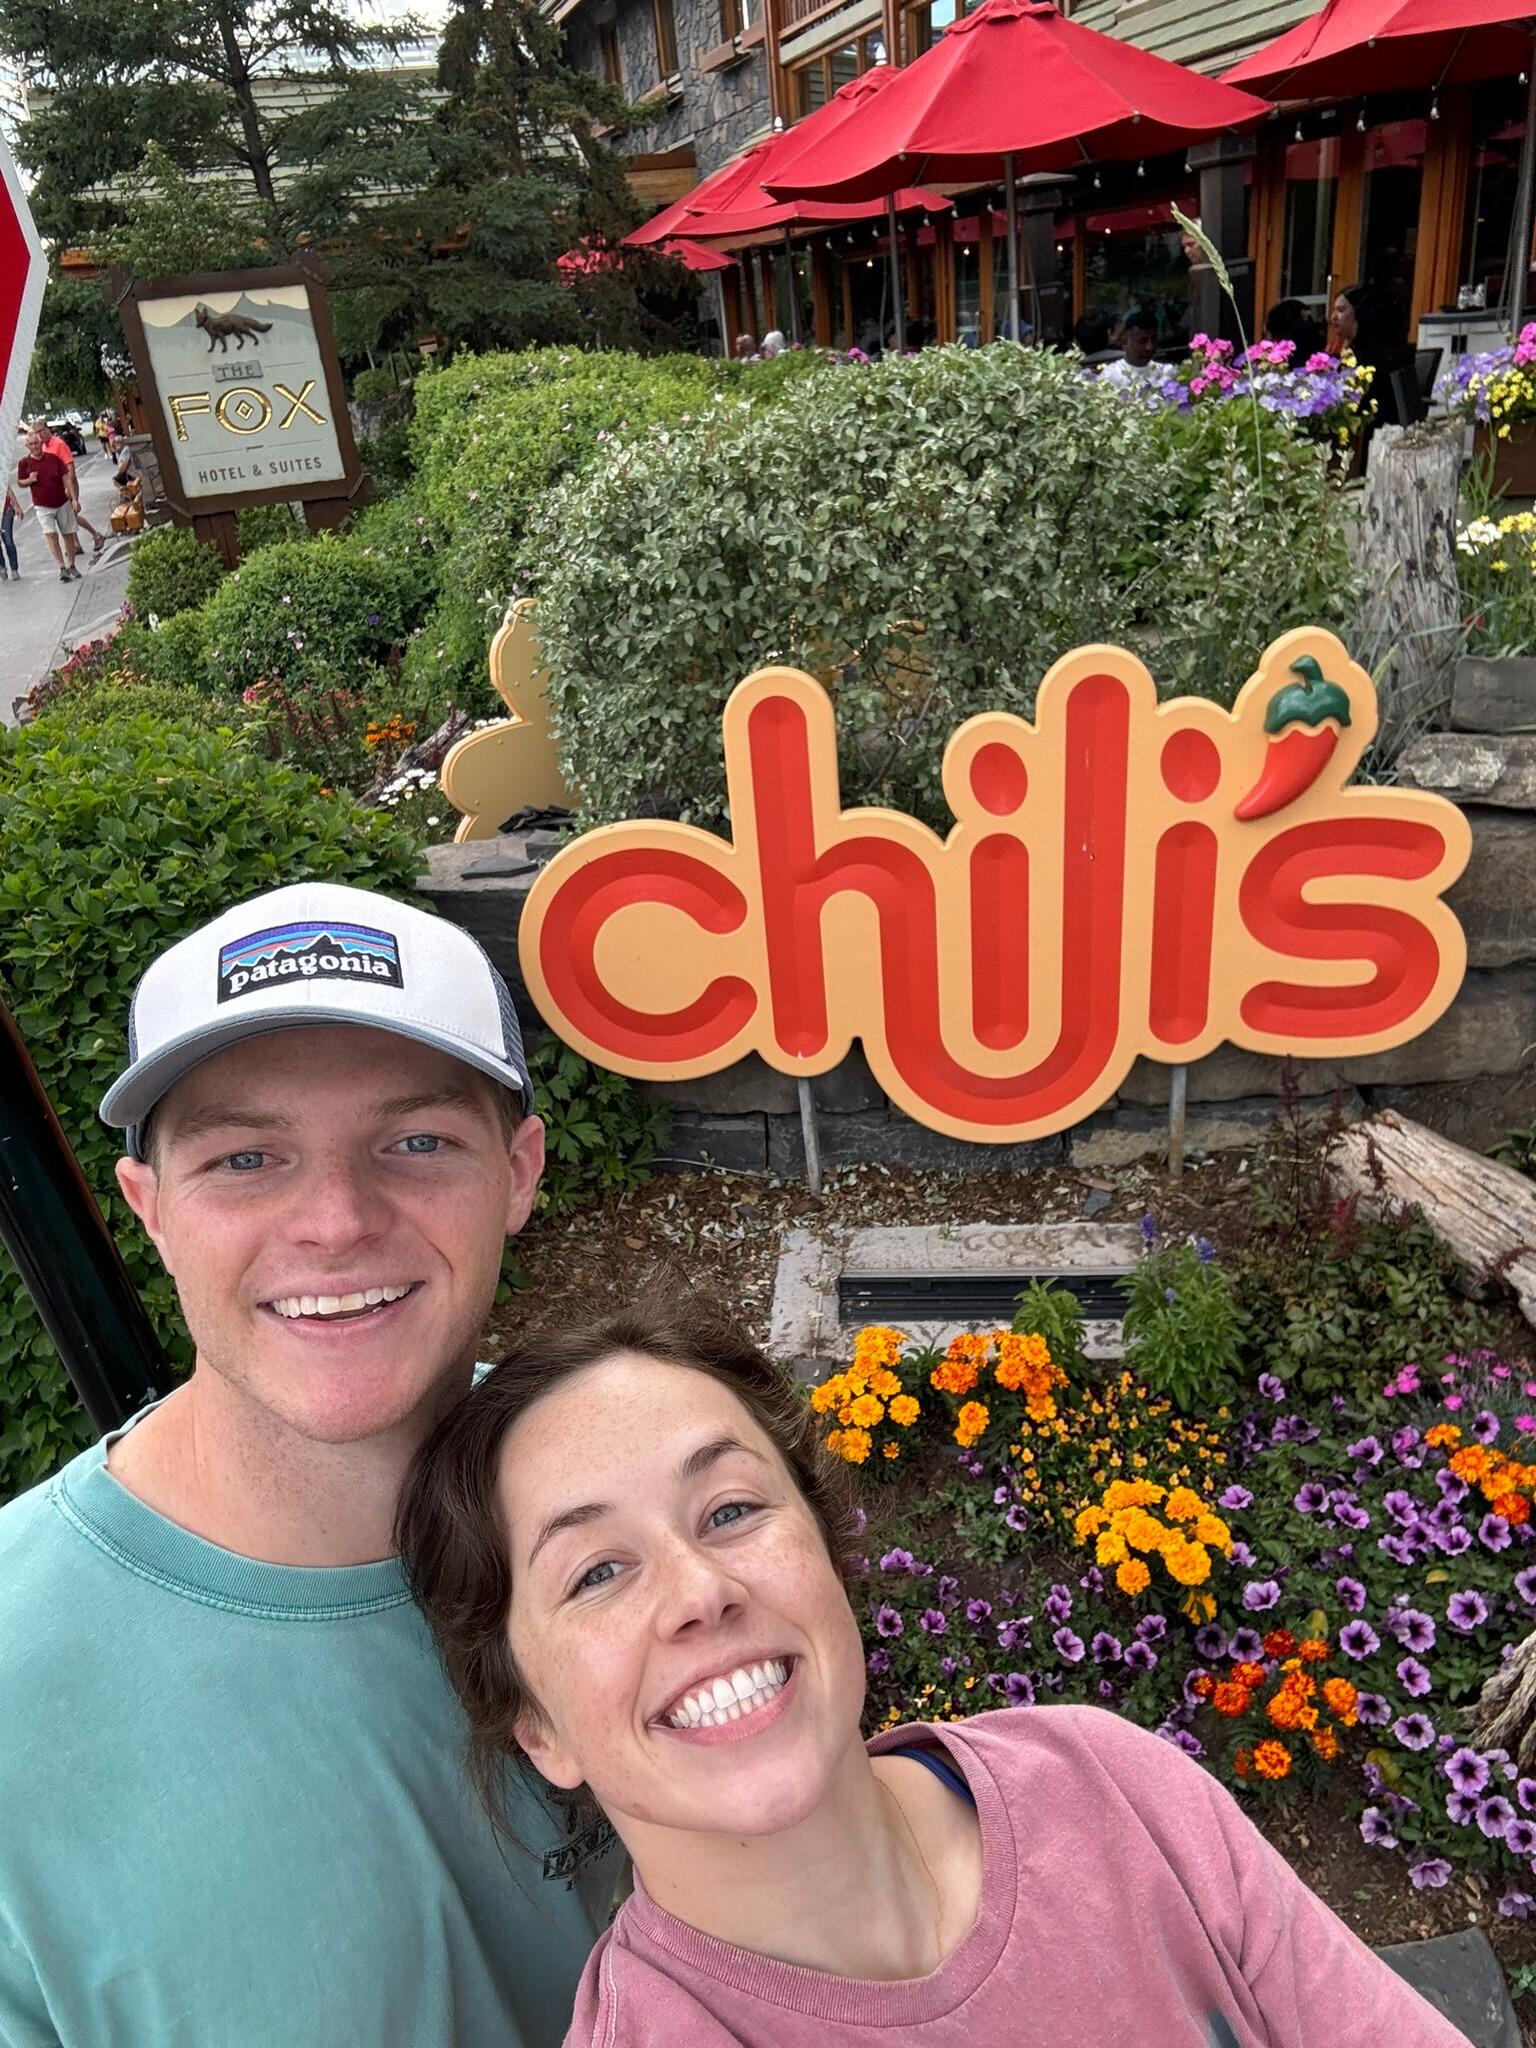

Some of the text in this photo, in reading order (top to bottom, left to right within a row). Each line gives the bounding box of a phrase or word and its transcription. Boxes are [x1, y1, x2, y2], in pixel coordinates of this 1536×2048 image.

[217, 365, 256, 379] THE
[168, 379, 328, 442] FOX
[198, 456, 323, 484] HOTEL & SUITES
[539, 654, 1446, 1126] chili's
[229, 952, 392, 994] patagonia
